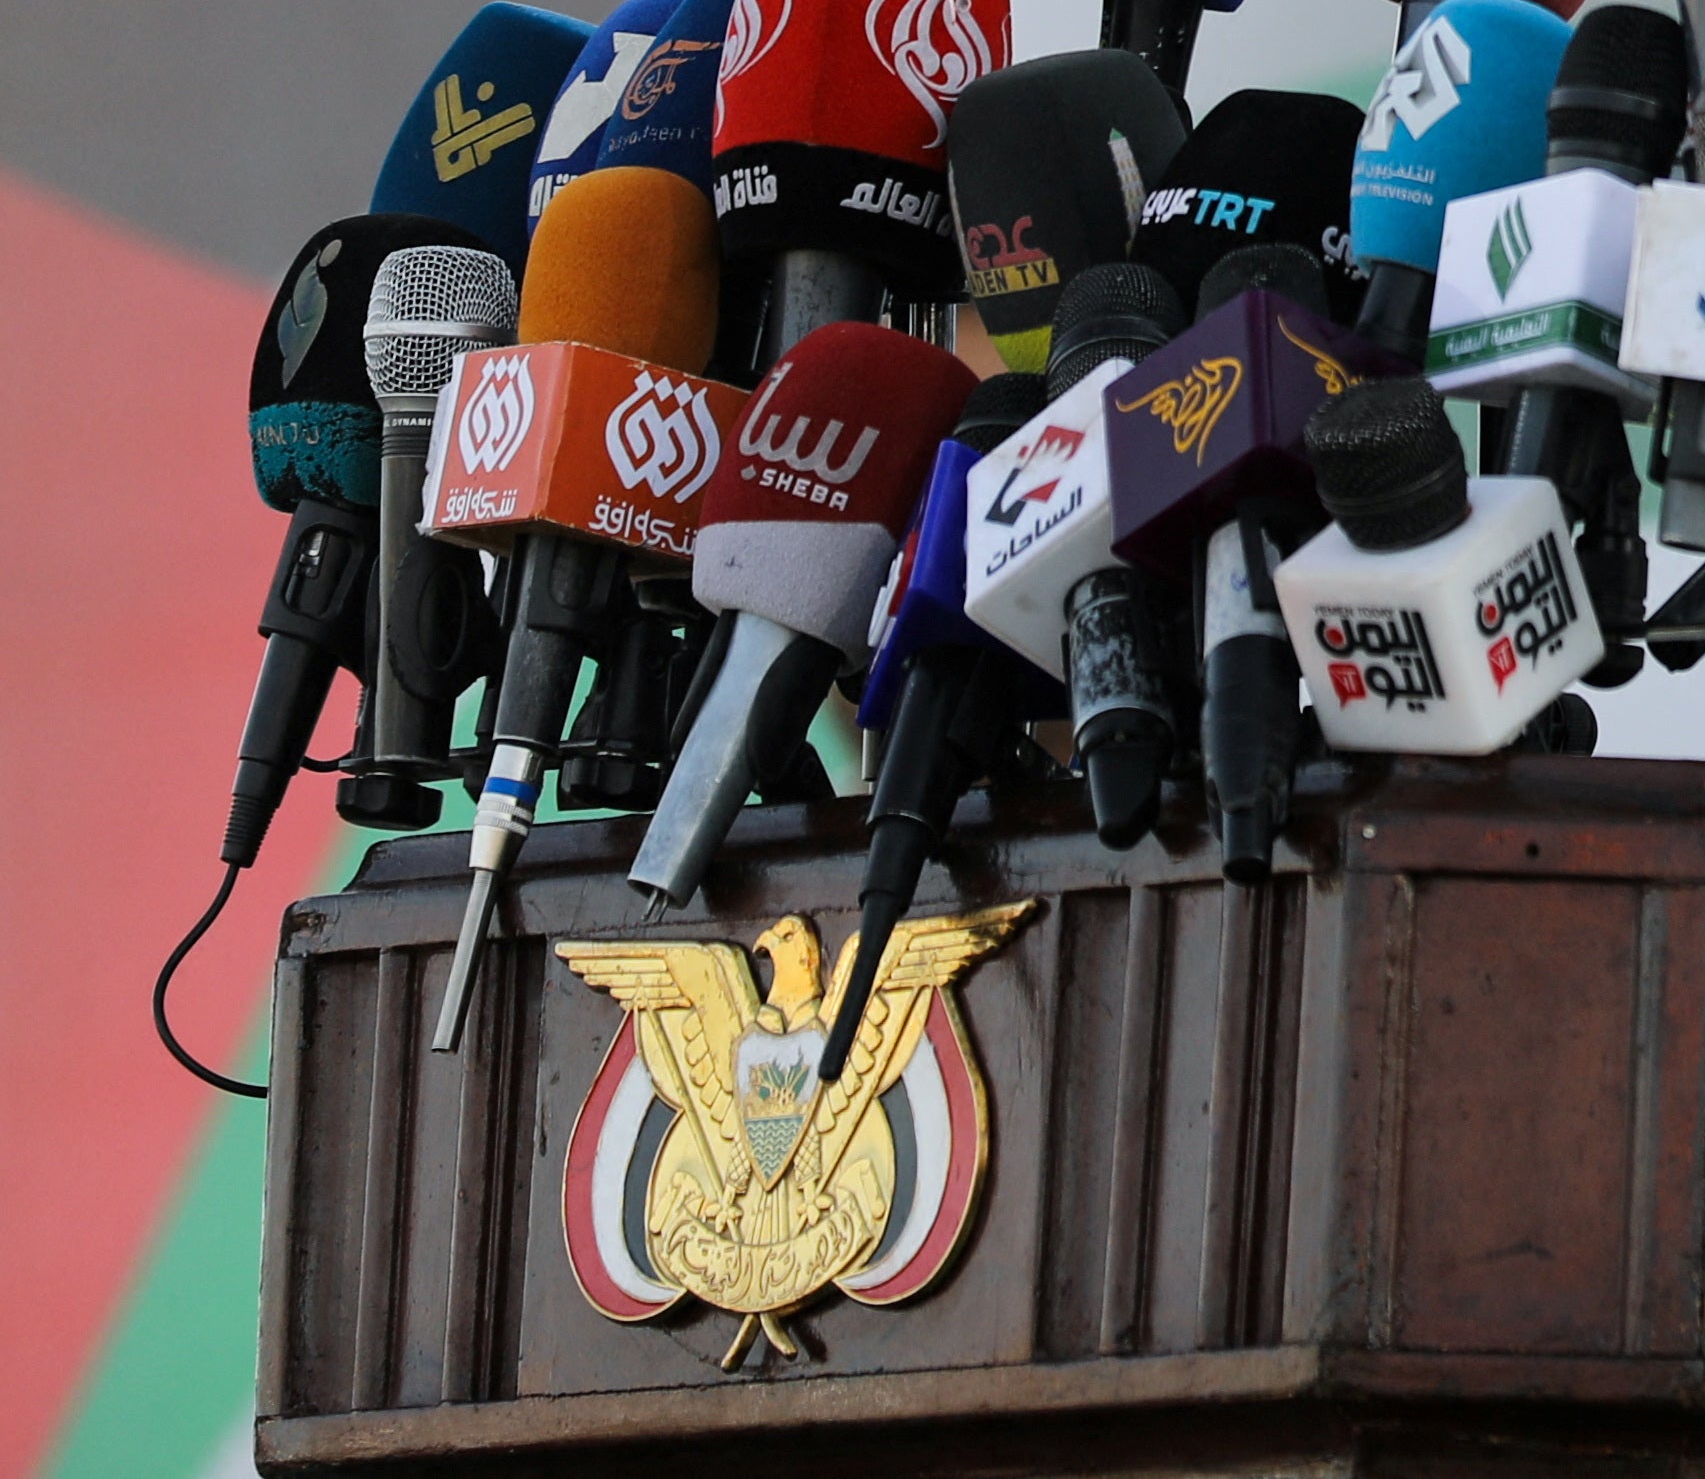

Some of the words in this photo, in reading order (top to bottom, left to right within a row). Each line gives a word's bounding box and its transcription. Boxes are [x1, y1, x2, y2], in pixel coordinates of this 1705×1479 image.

[733, 165, 778, 209] قناة
[839, 177, 943, 230] العالم
[1141, 187, 1197, 226] عربي
[1194, 189, 1275, 234] TRT
[1016, 261, 1049, 288] TV
[391, 417, 432, 427] DYNAMI
[758, 467, 849, 512] SHEBA
[1475, 531, 1566, 638] اليمن
[1313, 605, 1355, 618] YEMEN
[1357, 605, 1395, 619] TODAY
[1315, 610, 1432, 659] اليمن
